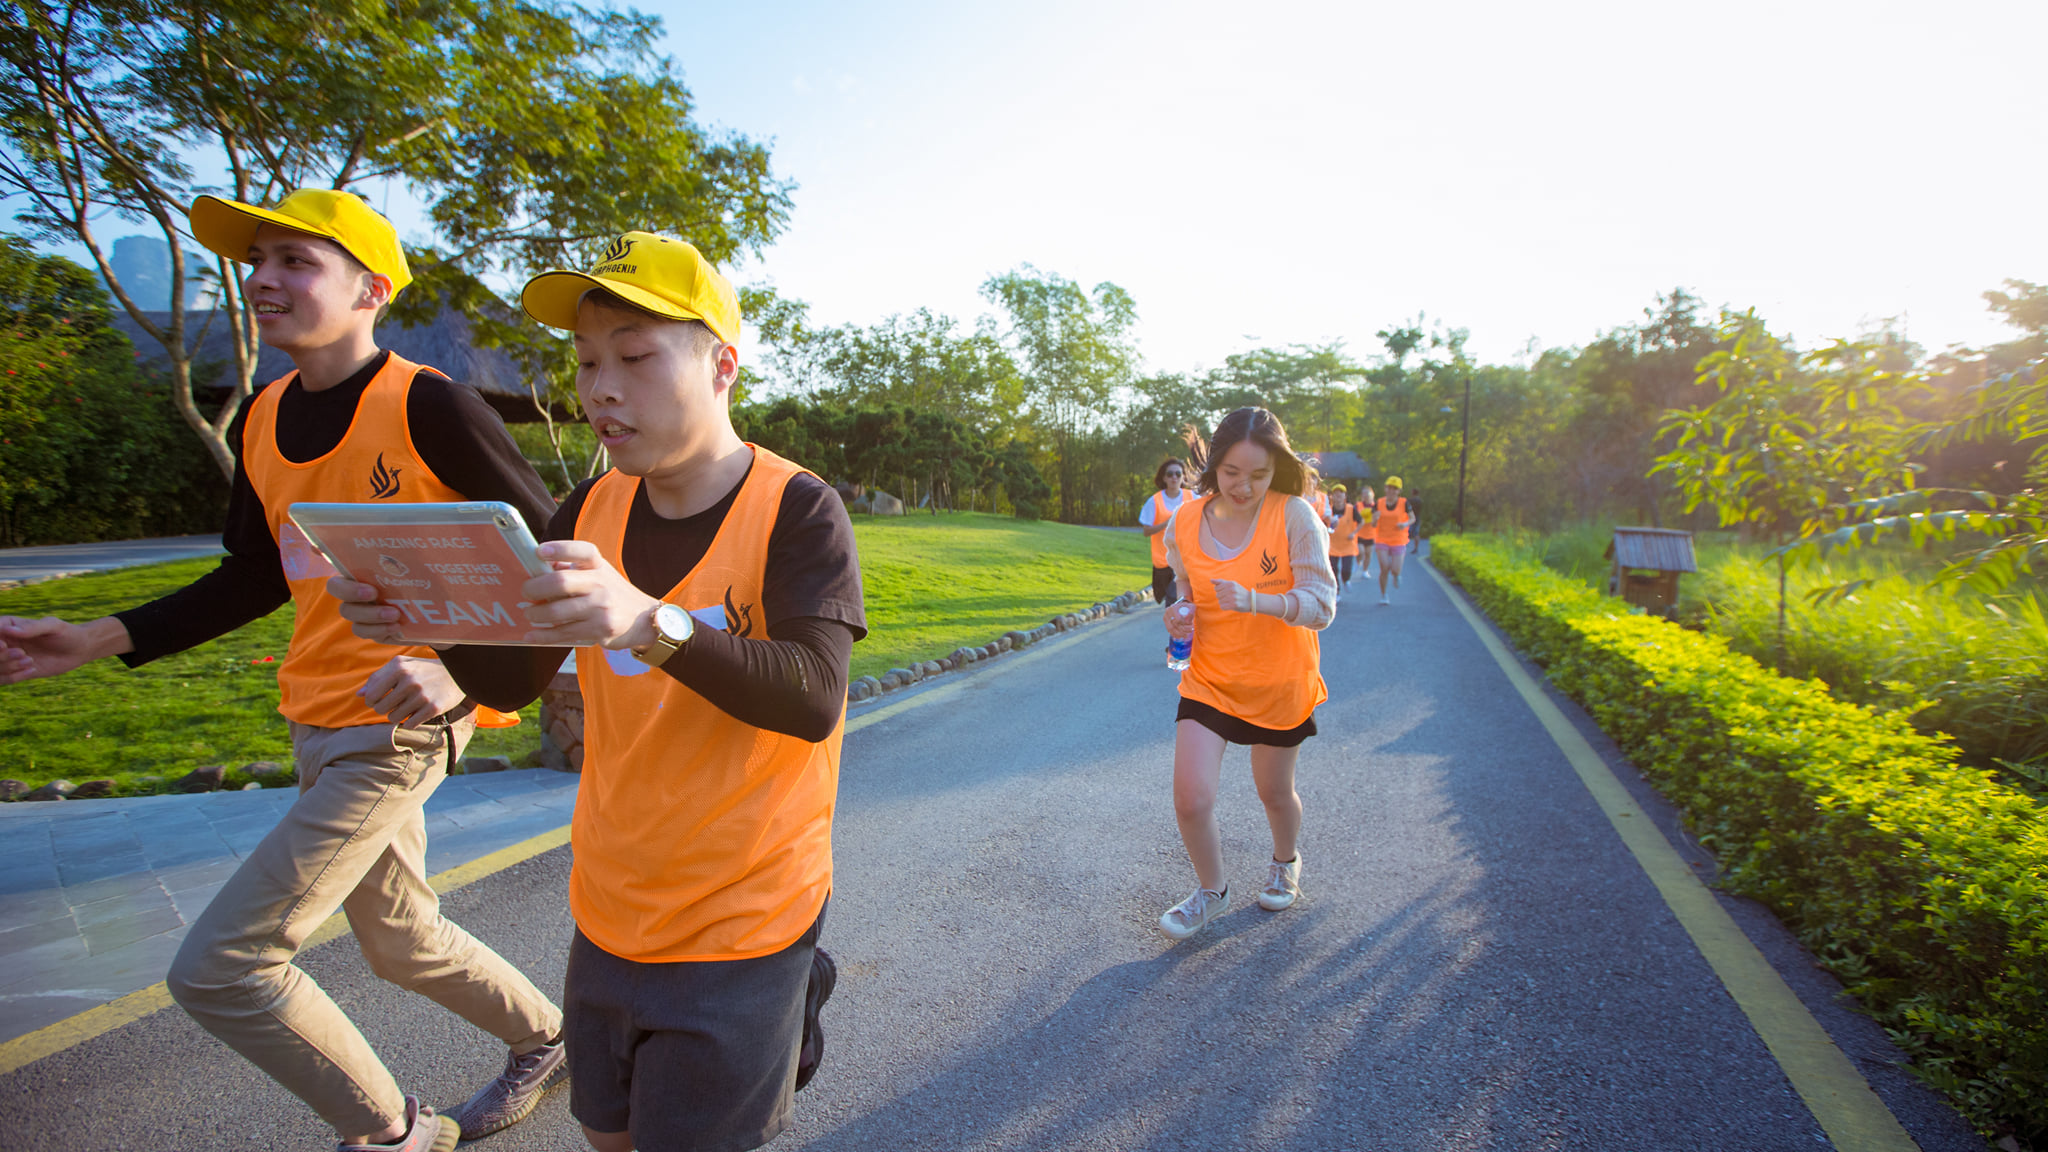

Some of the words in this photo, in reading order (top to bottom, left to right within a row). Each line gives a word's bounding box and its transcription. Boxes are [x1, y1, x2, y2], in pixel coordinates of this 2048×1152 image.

[353, 537, 428, 549] AMAZING
[428, 537, 476, 549] RACE
[424, 563, 503, 574] TOGETHER
[443, 575, 469, 585] WE
[469, 575, 502, 585] CAN
[385, 599, 517, 627] TEAM
